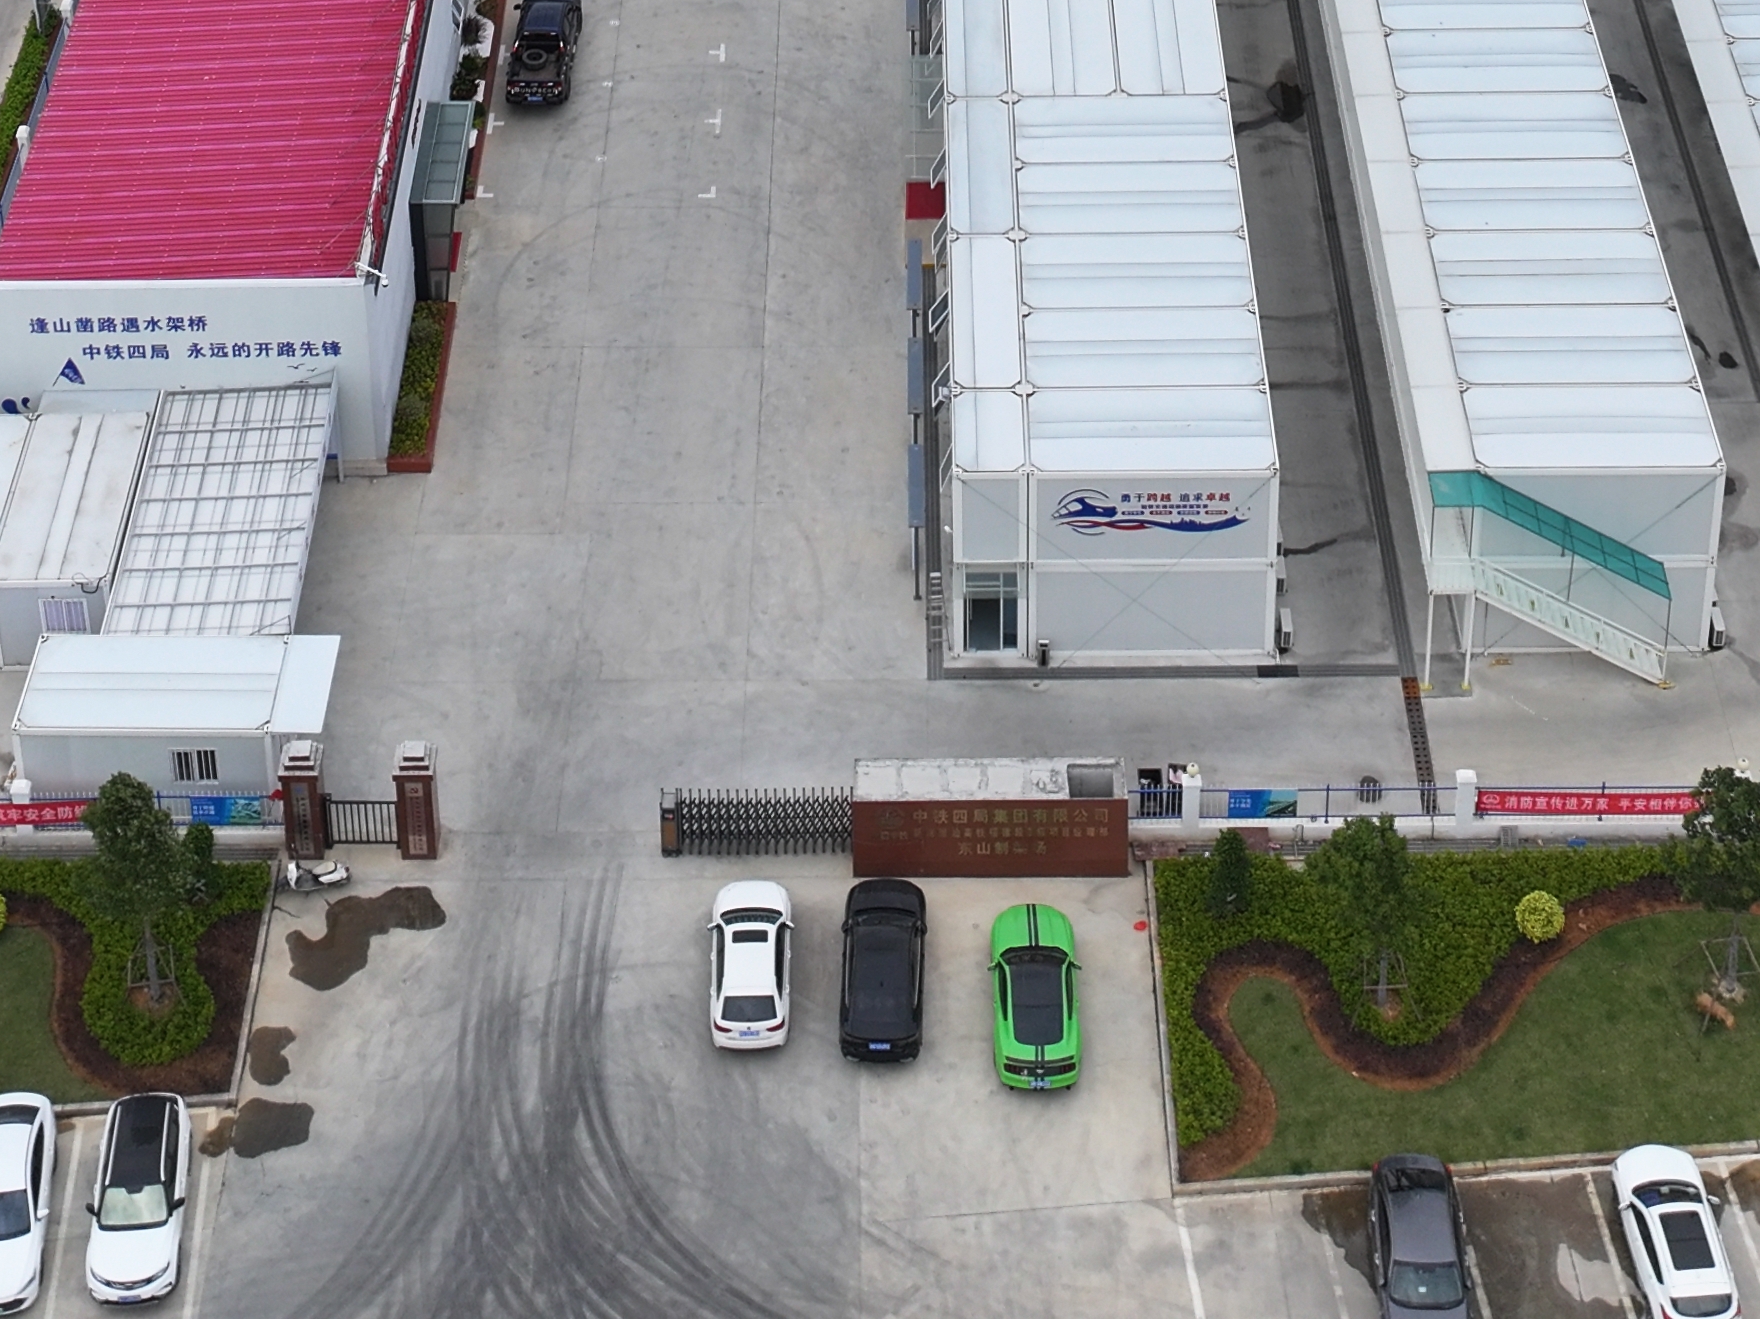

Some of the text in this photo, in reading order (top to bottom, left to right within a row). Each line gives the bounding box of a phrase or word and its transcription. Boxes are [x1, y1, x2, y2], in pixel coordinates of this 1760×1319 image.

[29, 315, 208, 334] 逢山凿路遇水架桥
[82, 340, 343, 361] 中铁四局 永远的开路先锋
[1120, 492, 1231, 503] 勇于跨越 追求卓越
[1504, 794, 1609, 811] 消防宣传进万家
[913, 807, 1109, 824] 中铁四局集团有限公司
